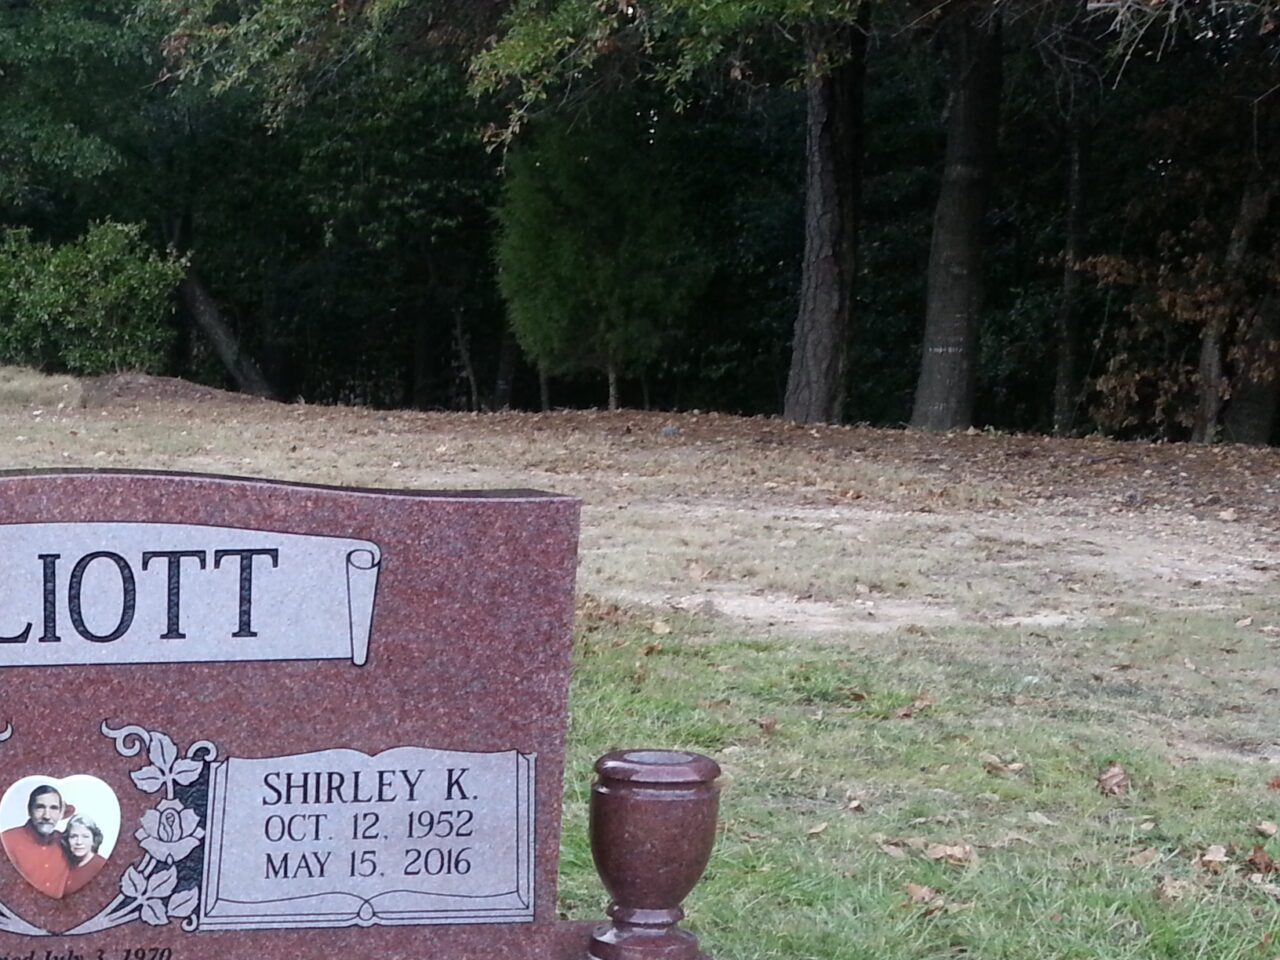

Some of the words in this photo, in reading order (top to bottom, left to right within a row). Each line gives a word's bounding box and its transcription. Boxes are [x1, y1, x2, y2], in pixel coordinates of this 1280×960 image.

[262, 769, 425, 806] SHIRLEY
[445, 767, 478, 801] K.
[264, 813, 333, 842] OCT.
[351, 812, 389, 840] 12,
[407, 809, 474, 839] 1952
[264, 851, 332, 879] MAY
[349, 850, 385, 878] 15,
[404, 847, 472, 876] 2016
